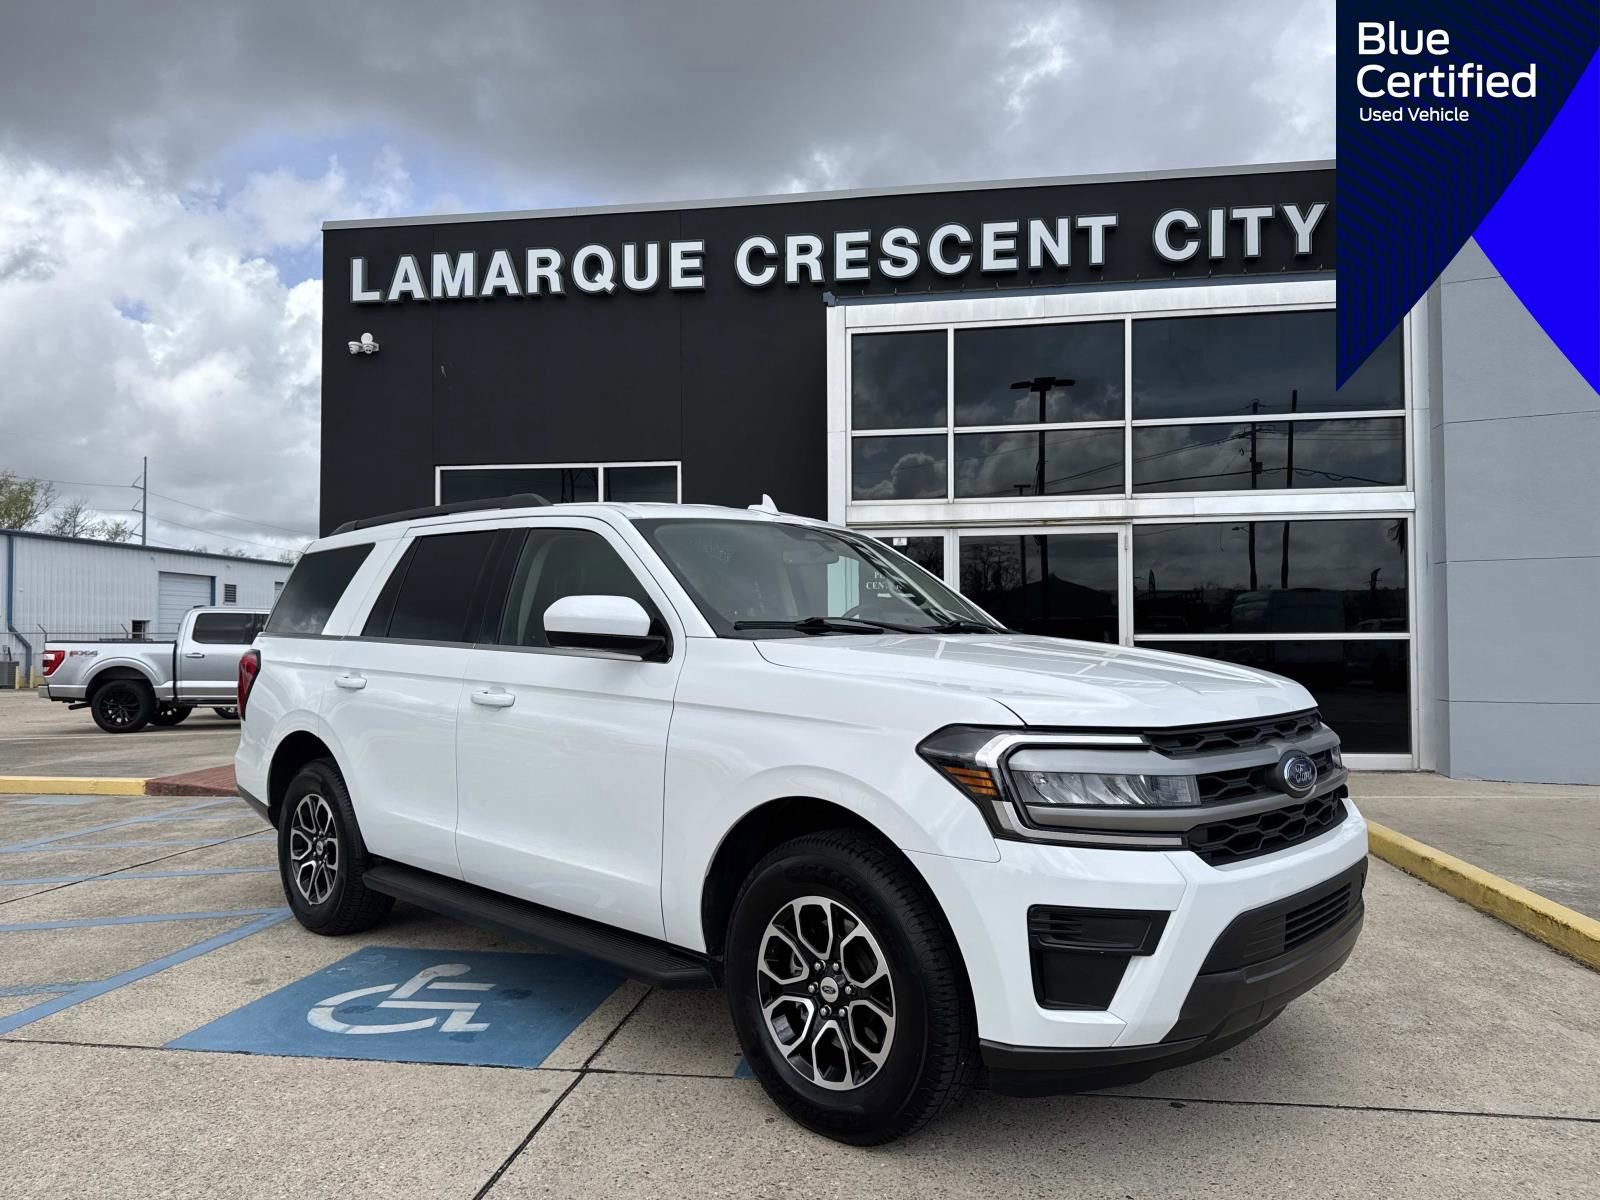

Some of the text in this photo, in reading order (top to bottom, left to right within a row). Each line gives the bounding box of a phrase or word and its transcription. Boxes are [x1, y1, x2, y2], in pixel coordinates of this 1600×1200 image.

[350, 202, 1329, 304] LAMARQUE CRESCENT CITY
[1294, 763, 1313, 784] Ford
